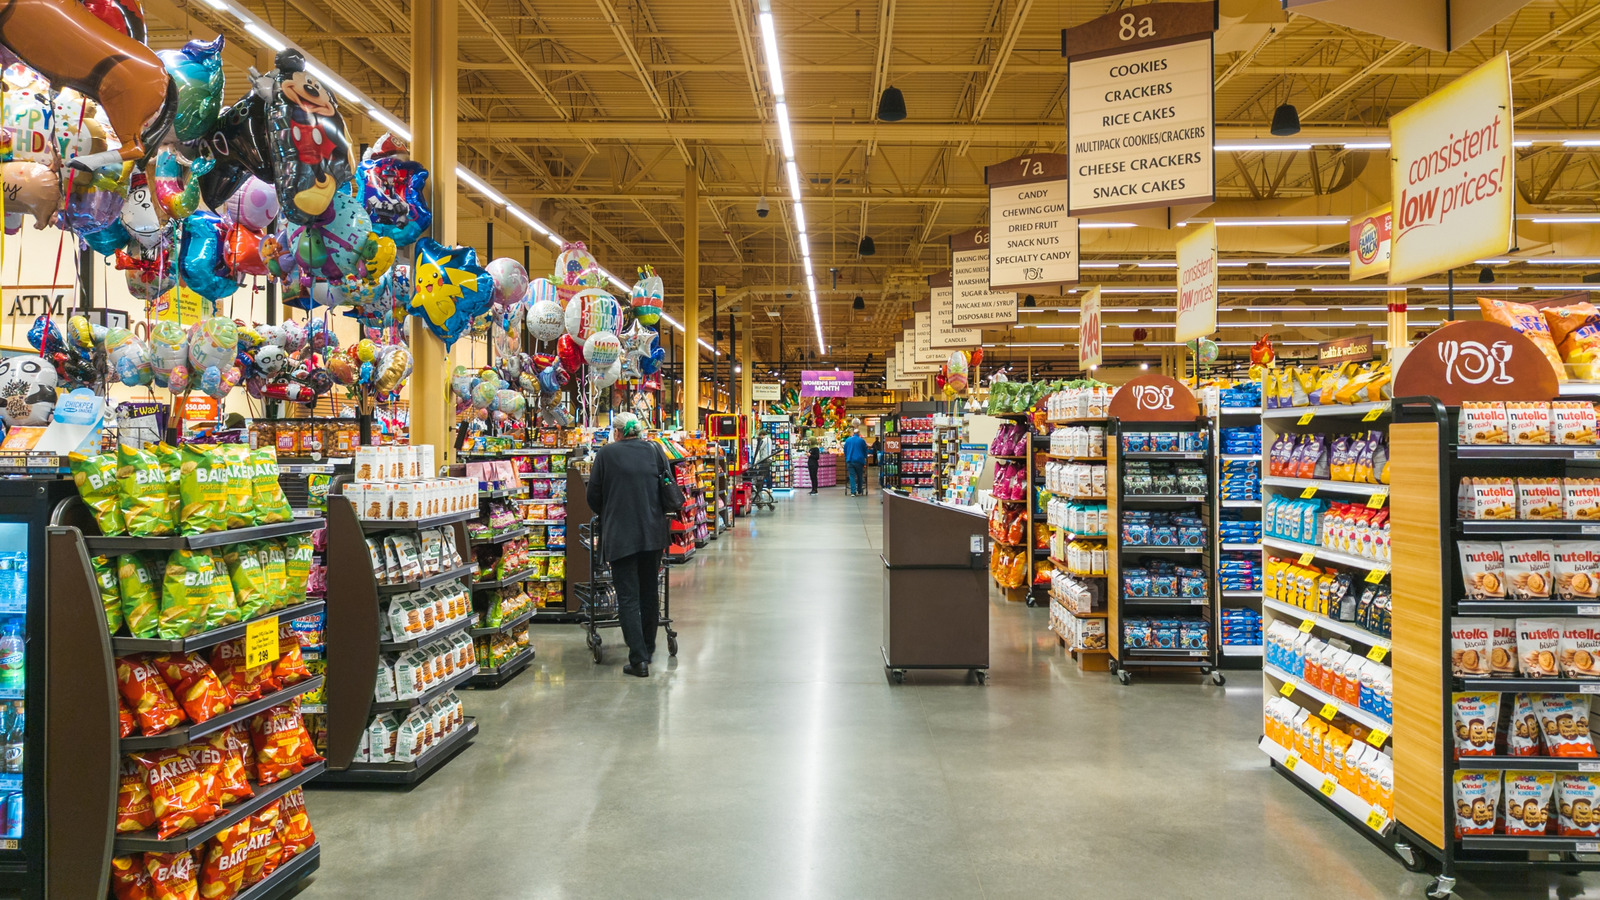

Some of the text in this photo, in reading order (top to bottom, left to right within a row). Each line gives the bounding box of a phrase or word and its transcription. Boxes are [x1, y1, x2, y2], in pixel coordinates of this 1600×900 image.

[1118, 12, 1157, 41] 8a
[1109, 58, 1168, 78] COOKIES
[1104, 82, 1173, 103] CRACKERS
[1102, 106, 1176, 127] RICE CAKES
[1075, 126, 1205, 154] MULTIPACK COOKIES/CRACKERS
[1408, 114, 1501, 186] consistent
[1019, 158, 1045, 177] 7a
[1078, 151, 1202, 177] CHEESE CRACKERS
[1018, 189, 1048, 200] CANDY
[1093, 177, 1186, 199] SNACK CAKES
[1398, 155, 1507, 230] low prices!
[1002, 203, 1065, 218] CHEWING GUM
[1008, 220, 1058, 233] DRIED FRUIT
[1007, 236, 1059, 249] SNACK NUTS
[1358, 229, 1378, 249] FAMILY
[1361, 239, 1378, 258] PACK
[956, 255, 976, 263] BAKING
[995, 250, 1071, 265] SPECIALTY CANDY
[1182, 253, 1215, 286] consistent
[1178, 278, 1215, 312] low prices!
[8, 294, 65, 317] ATM
[583, 295, 619, 313] HAPPY
[584, 312, 621, 329] BIRTHDAY
[957, 312, 994, 321] DISPOSABLE
[1320, 342, 1368, 360] health & wellness
[64, 401, 94, 410] CHICKPEA
[139, 405, 160, 415] Way!
[1466, 410, 1505, 421] nutella
[1510, 410, 1548, 421] nutella
[1556, 410, 1594, 420] nutella
[1476, 487, 1514, 497] nutella
[1522, 487, 1560, 497] nutella
[1509, 551, 1550, 564] nutella
[1554, 551, 1600, 563] nutella
[1451, 628, 1488, 639] utella
[1521, 628, 1560, 640] nutella
[1563, 628, 1600, 640] utella
